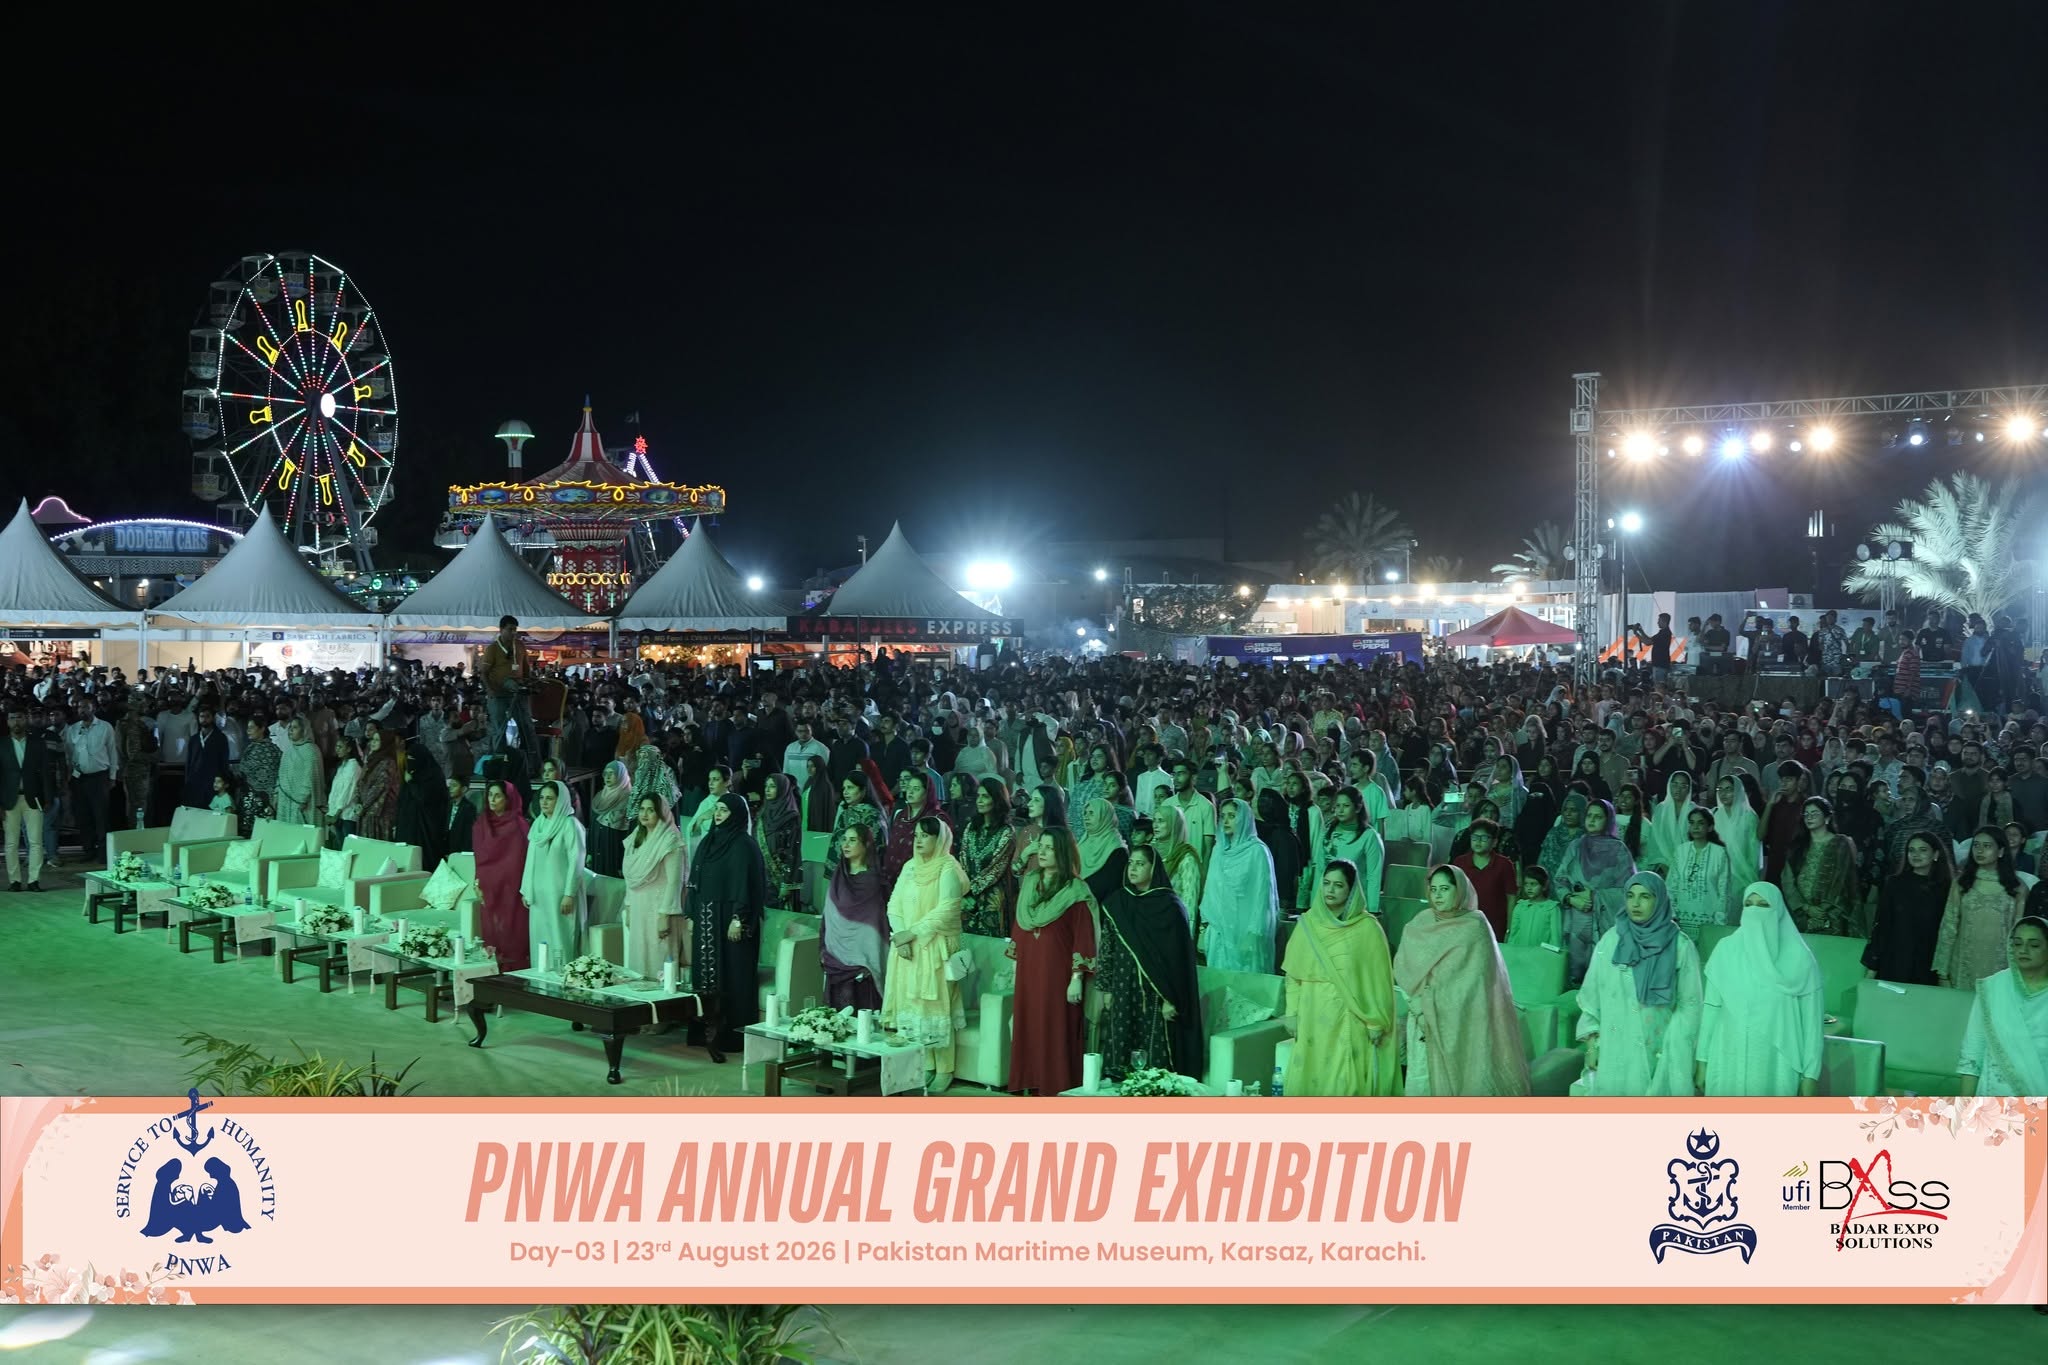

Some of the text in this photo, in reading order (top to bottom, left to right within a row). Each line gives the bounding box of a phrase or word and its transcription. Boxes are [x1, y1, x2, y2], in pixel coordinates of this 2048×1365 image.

[115, 527, 208, 552] DODGEM CARS
[927, 620, 1012, 635] EXPRESS
